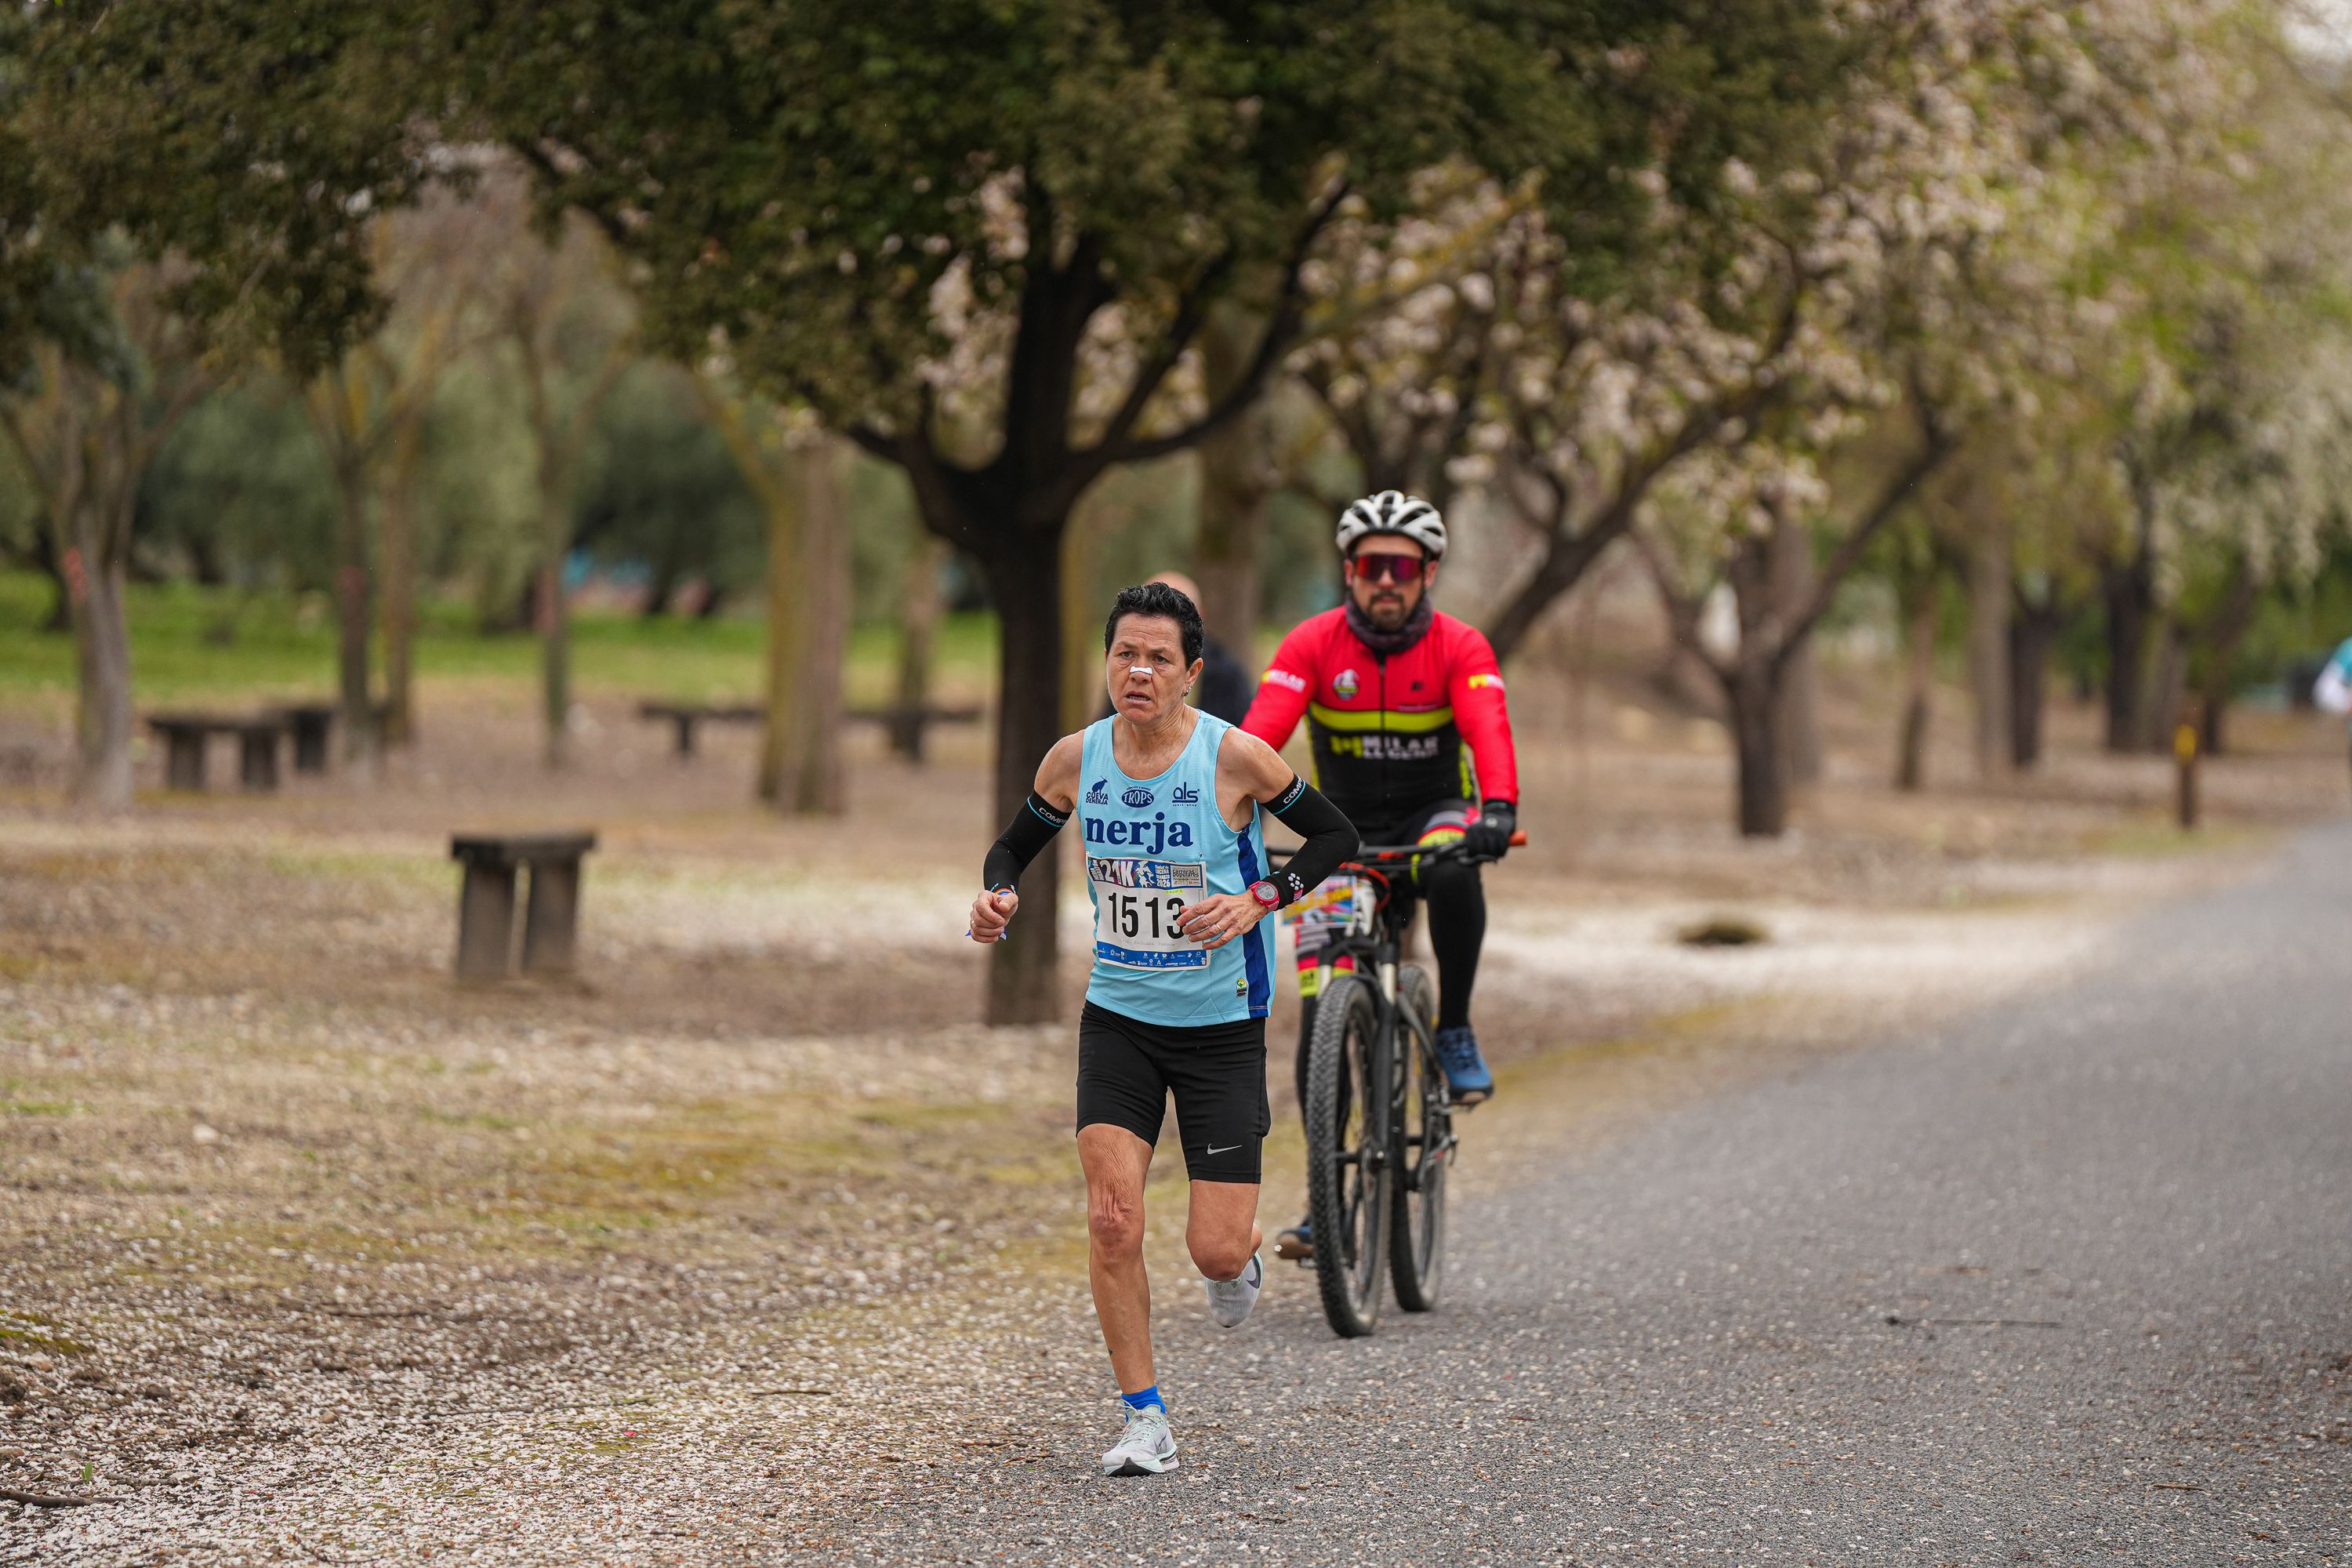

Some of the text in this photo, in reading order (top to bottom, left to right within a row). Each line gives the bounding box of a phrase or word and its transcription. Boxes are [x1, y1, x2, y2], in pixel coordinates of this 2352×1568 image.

[1123, 790, 1152, 804] TROPS
[1085, 811, 1193, 855] nerja
[1099, 859, 1134, 887] 21K
[1156, 879, 1171, 887] 2026
[1109, 892, 1185, 939] 1513
